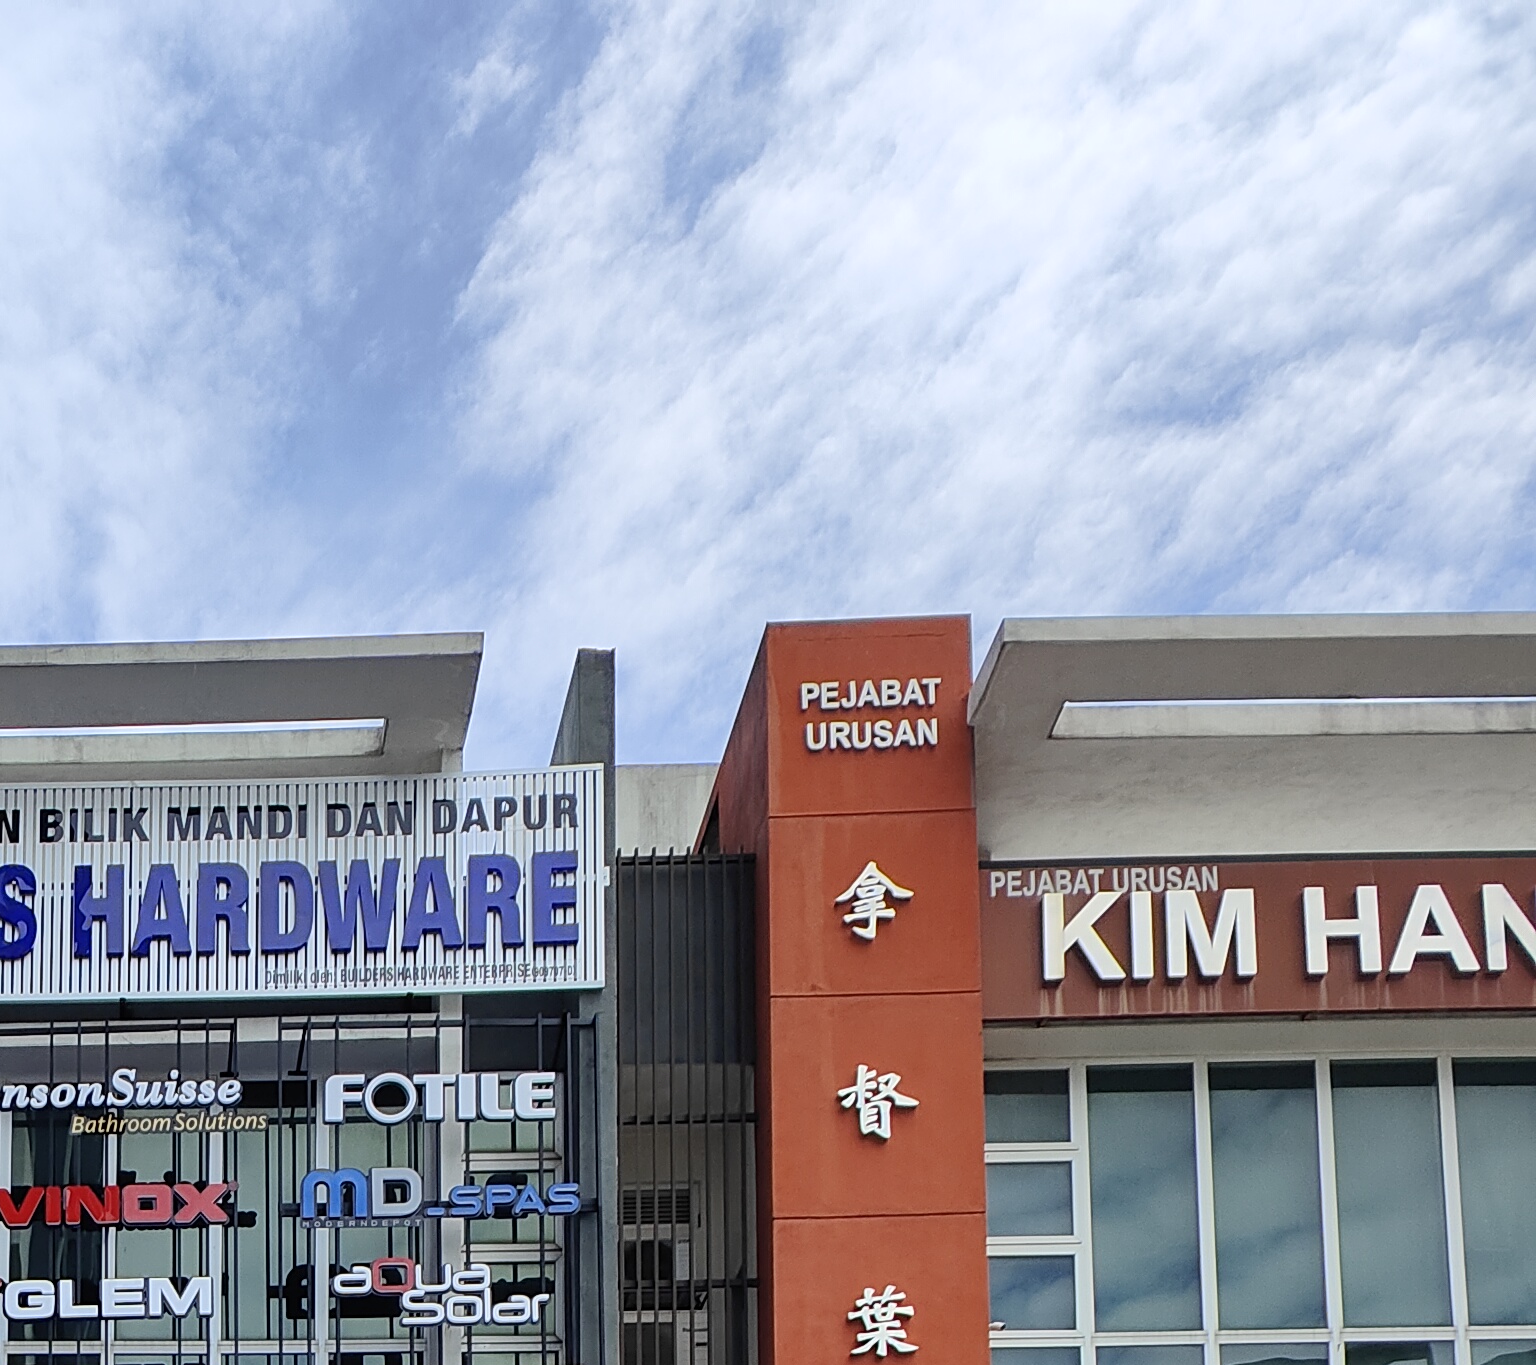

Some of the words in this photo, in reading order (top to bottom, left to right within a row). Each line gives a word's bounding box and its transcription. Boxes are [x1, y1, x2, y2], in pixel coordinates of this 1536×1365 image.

[801, 676, 942, 711] PEJABAT
[806, 718, 939, 753] URUSAN
[40, 806, 150, 844] BILIK
[167, 803, 308, 842] MANDI
[326, 799, 416, 839] DAN
[432, 793, 579, 835] DAPUR
[990, 868, 1104, 898] PEJABAT
[1113, 866, 1219, 893] URUSAN
[74, 850, 580, 959] HARDWARE
[1041, 887, 1259, 984] KIM
[397, 964, 460, 982] HARDWARE
[324, 1071, 557, 1124] FOTILE
[70, 1115, 171, 1134] Bathroom
[174, 1113, 269, 1132] Solutions
[4, 1276, 214, 1320] GLEM
